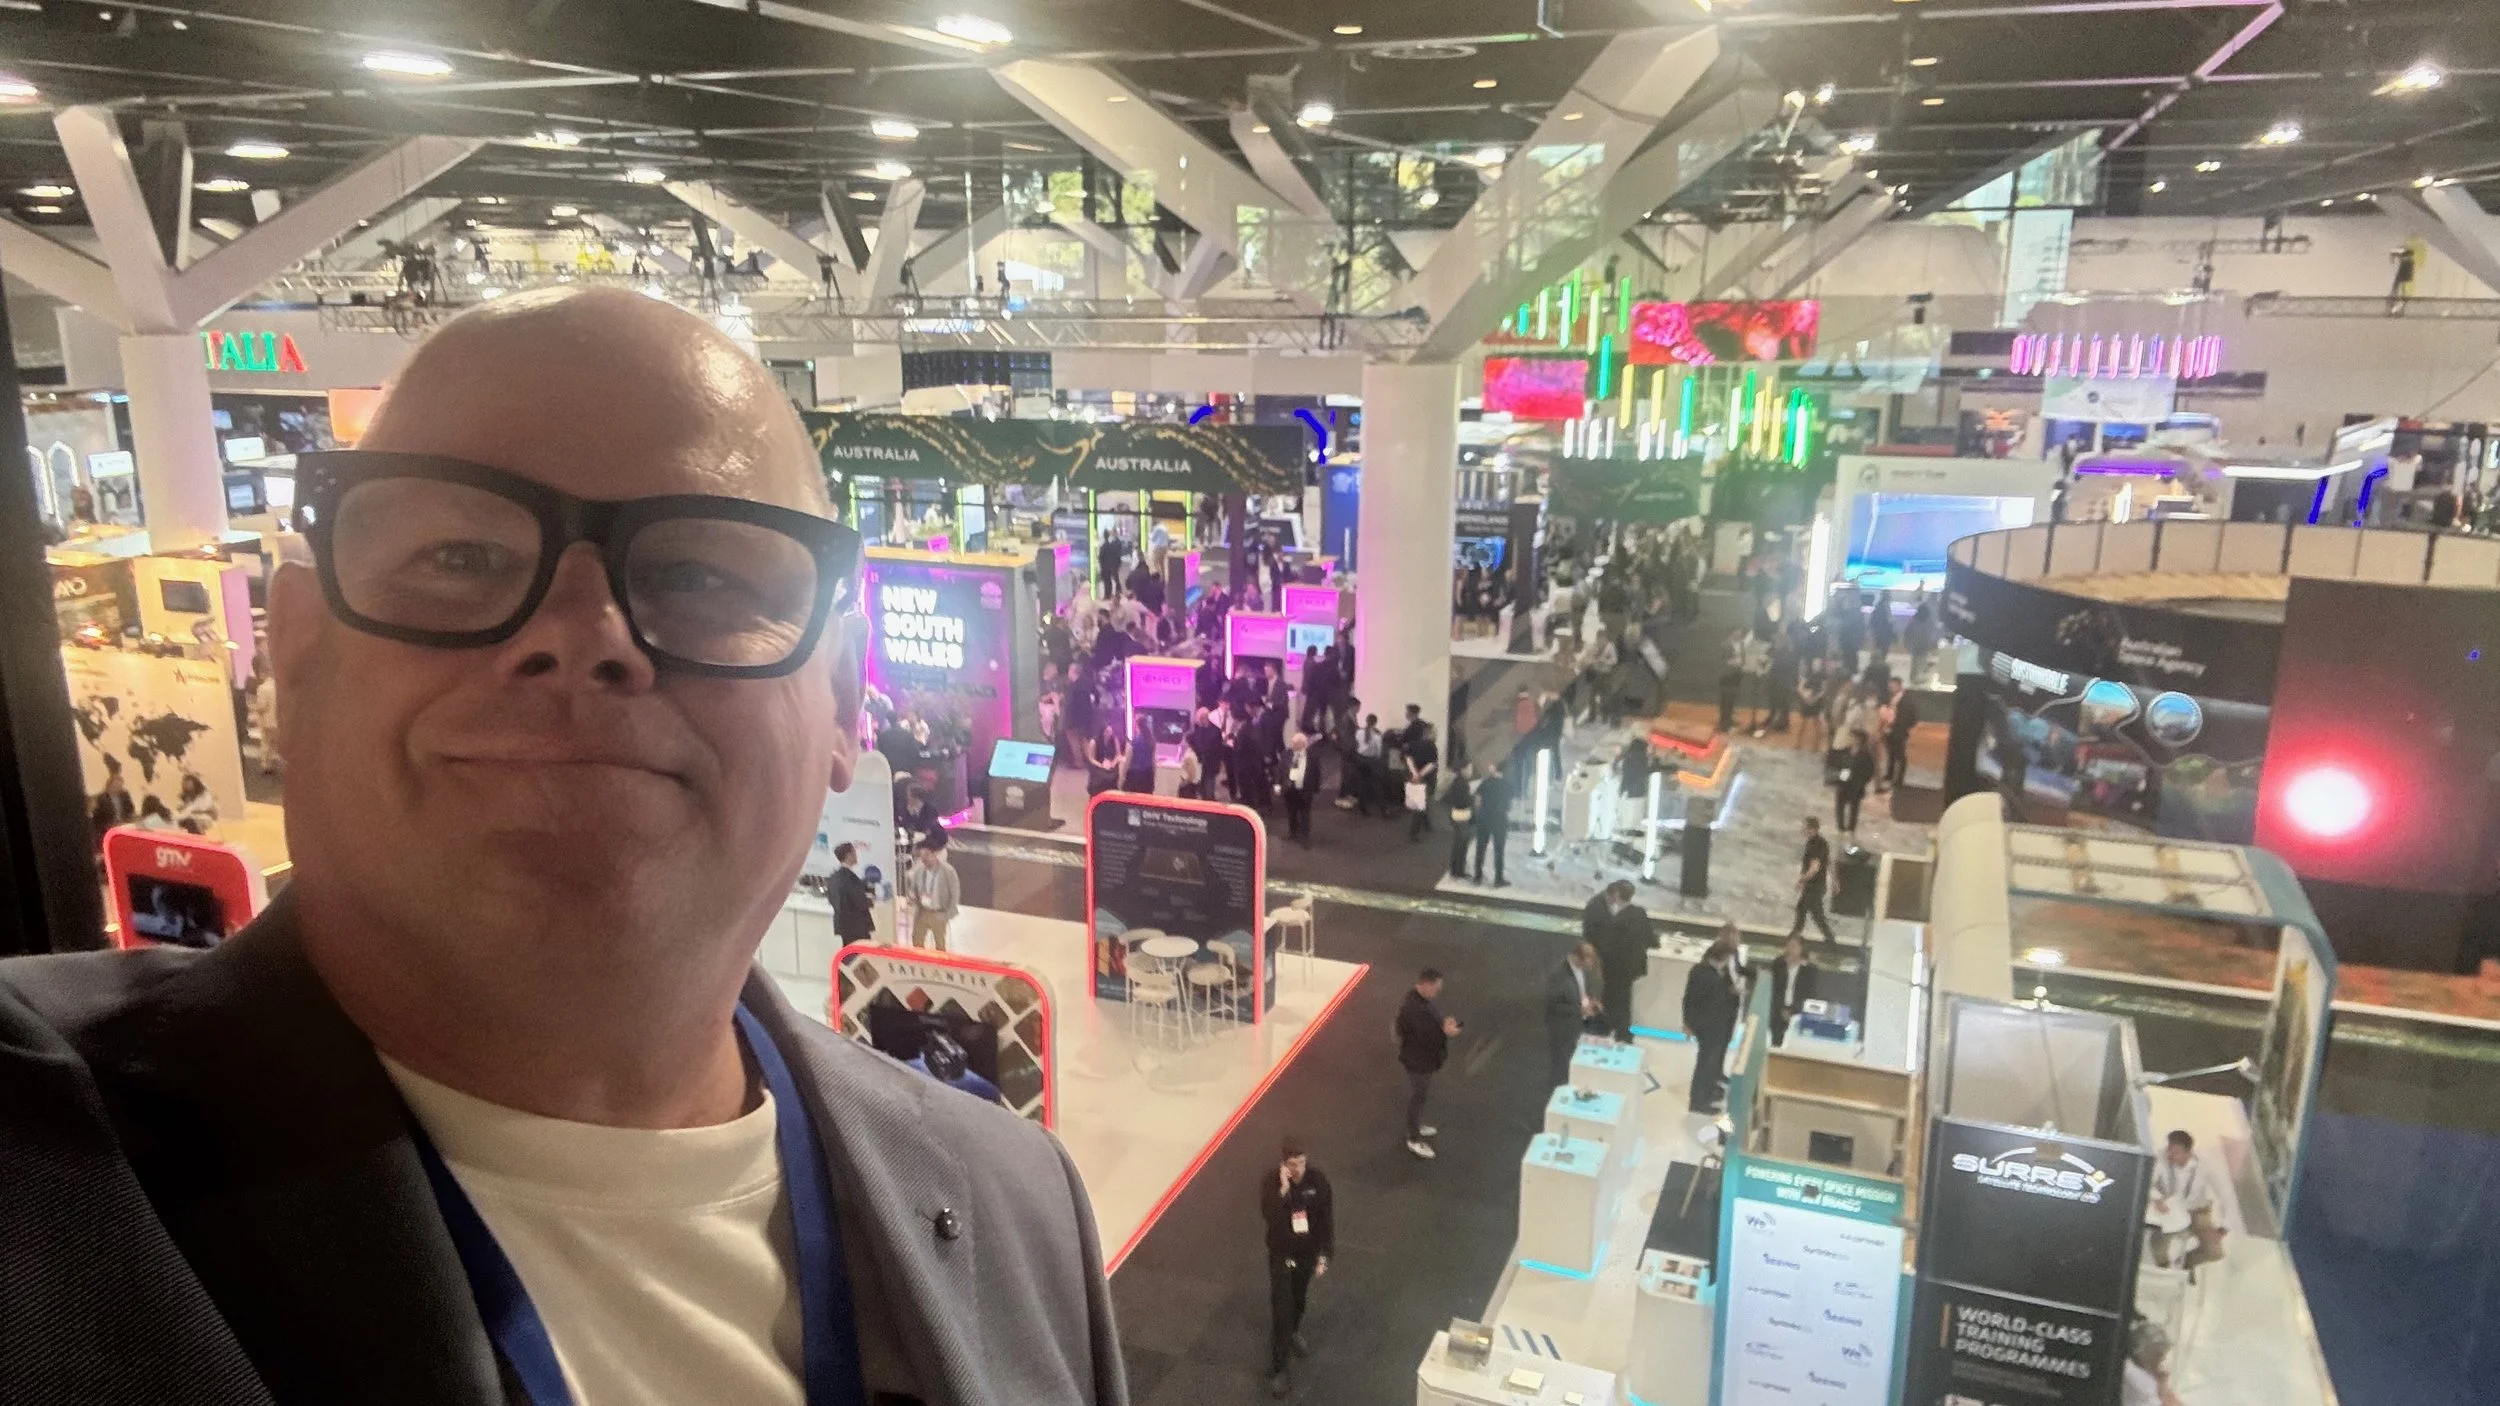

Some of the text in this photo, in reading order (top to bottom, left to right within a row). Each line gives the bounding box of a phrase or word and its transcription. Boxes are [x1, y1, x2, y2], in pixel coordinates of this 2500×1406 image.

[833, 445, 920, 463] AUSTRALIA
[1095, 456, 1192, 474] AUSTRALIA
[882, 585, 938, 615] NEW
[883, 611, 965, 644] SOUTH
[884, 637, 964, 669] WALES
[1951, 1151, 2116, 1193] SURREY
[1956, 1321, 2046, 1353] TRAINING
[1957, 1305, 2093, 1346] WORLD-CLASS
[1954, 1337, 2092, 1379] PROGRAMMES
